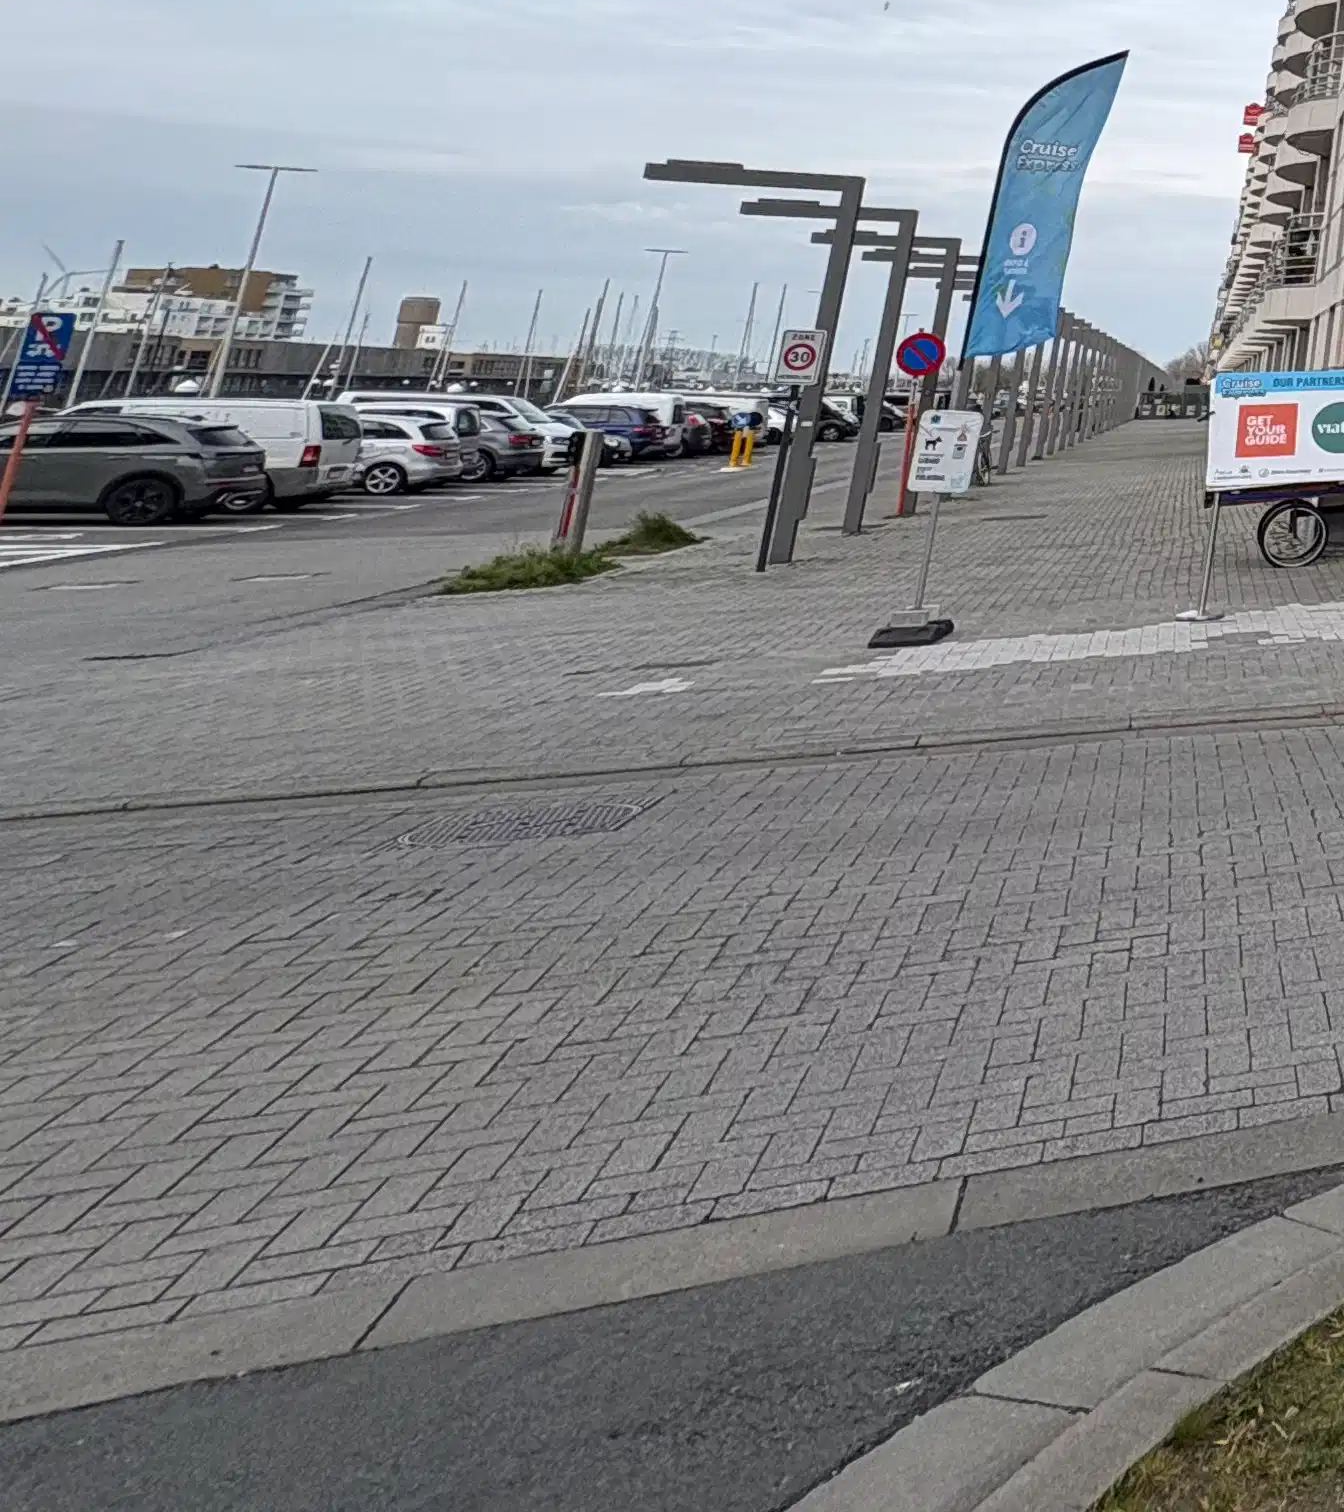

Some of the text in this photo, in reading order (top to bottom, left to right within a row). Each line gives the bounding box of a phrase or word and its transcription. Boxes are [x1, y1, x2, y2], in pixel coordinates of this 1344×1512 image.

[1020, 139, 1078, 157] Cruise
[1017, 155, 1080, 172] Express
[790, 351, 810, 363] 30
[1222, 376, 1262, 388] Cruise
[1273, 377, 1294, 388] OUR
[1246, 414, 1274, 426] GET
[1246, 425, 1287, 437] YOUR
[1244, 434, 1288, 447] GUIDE
